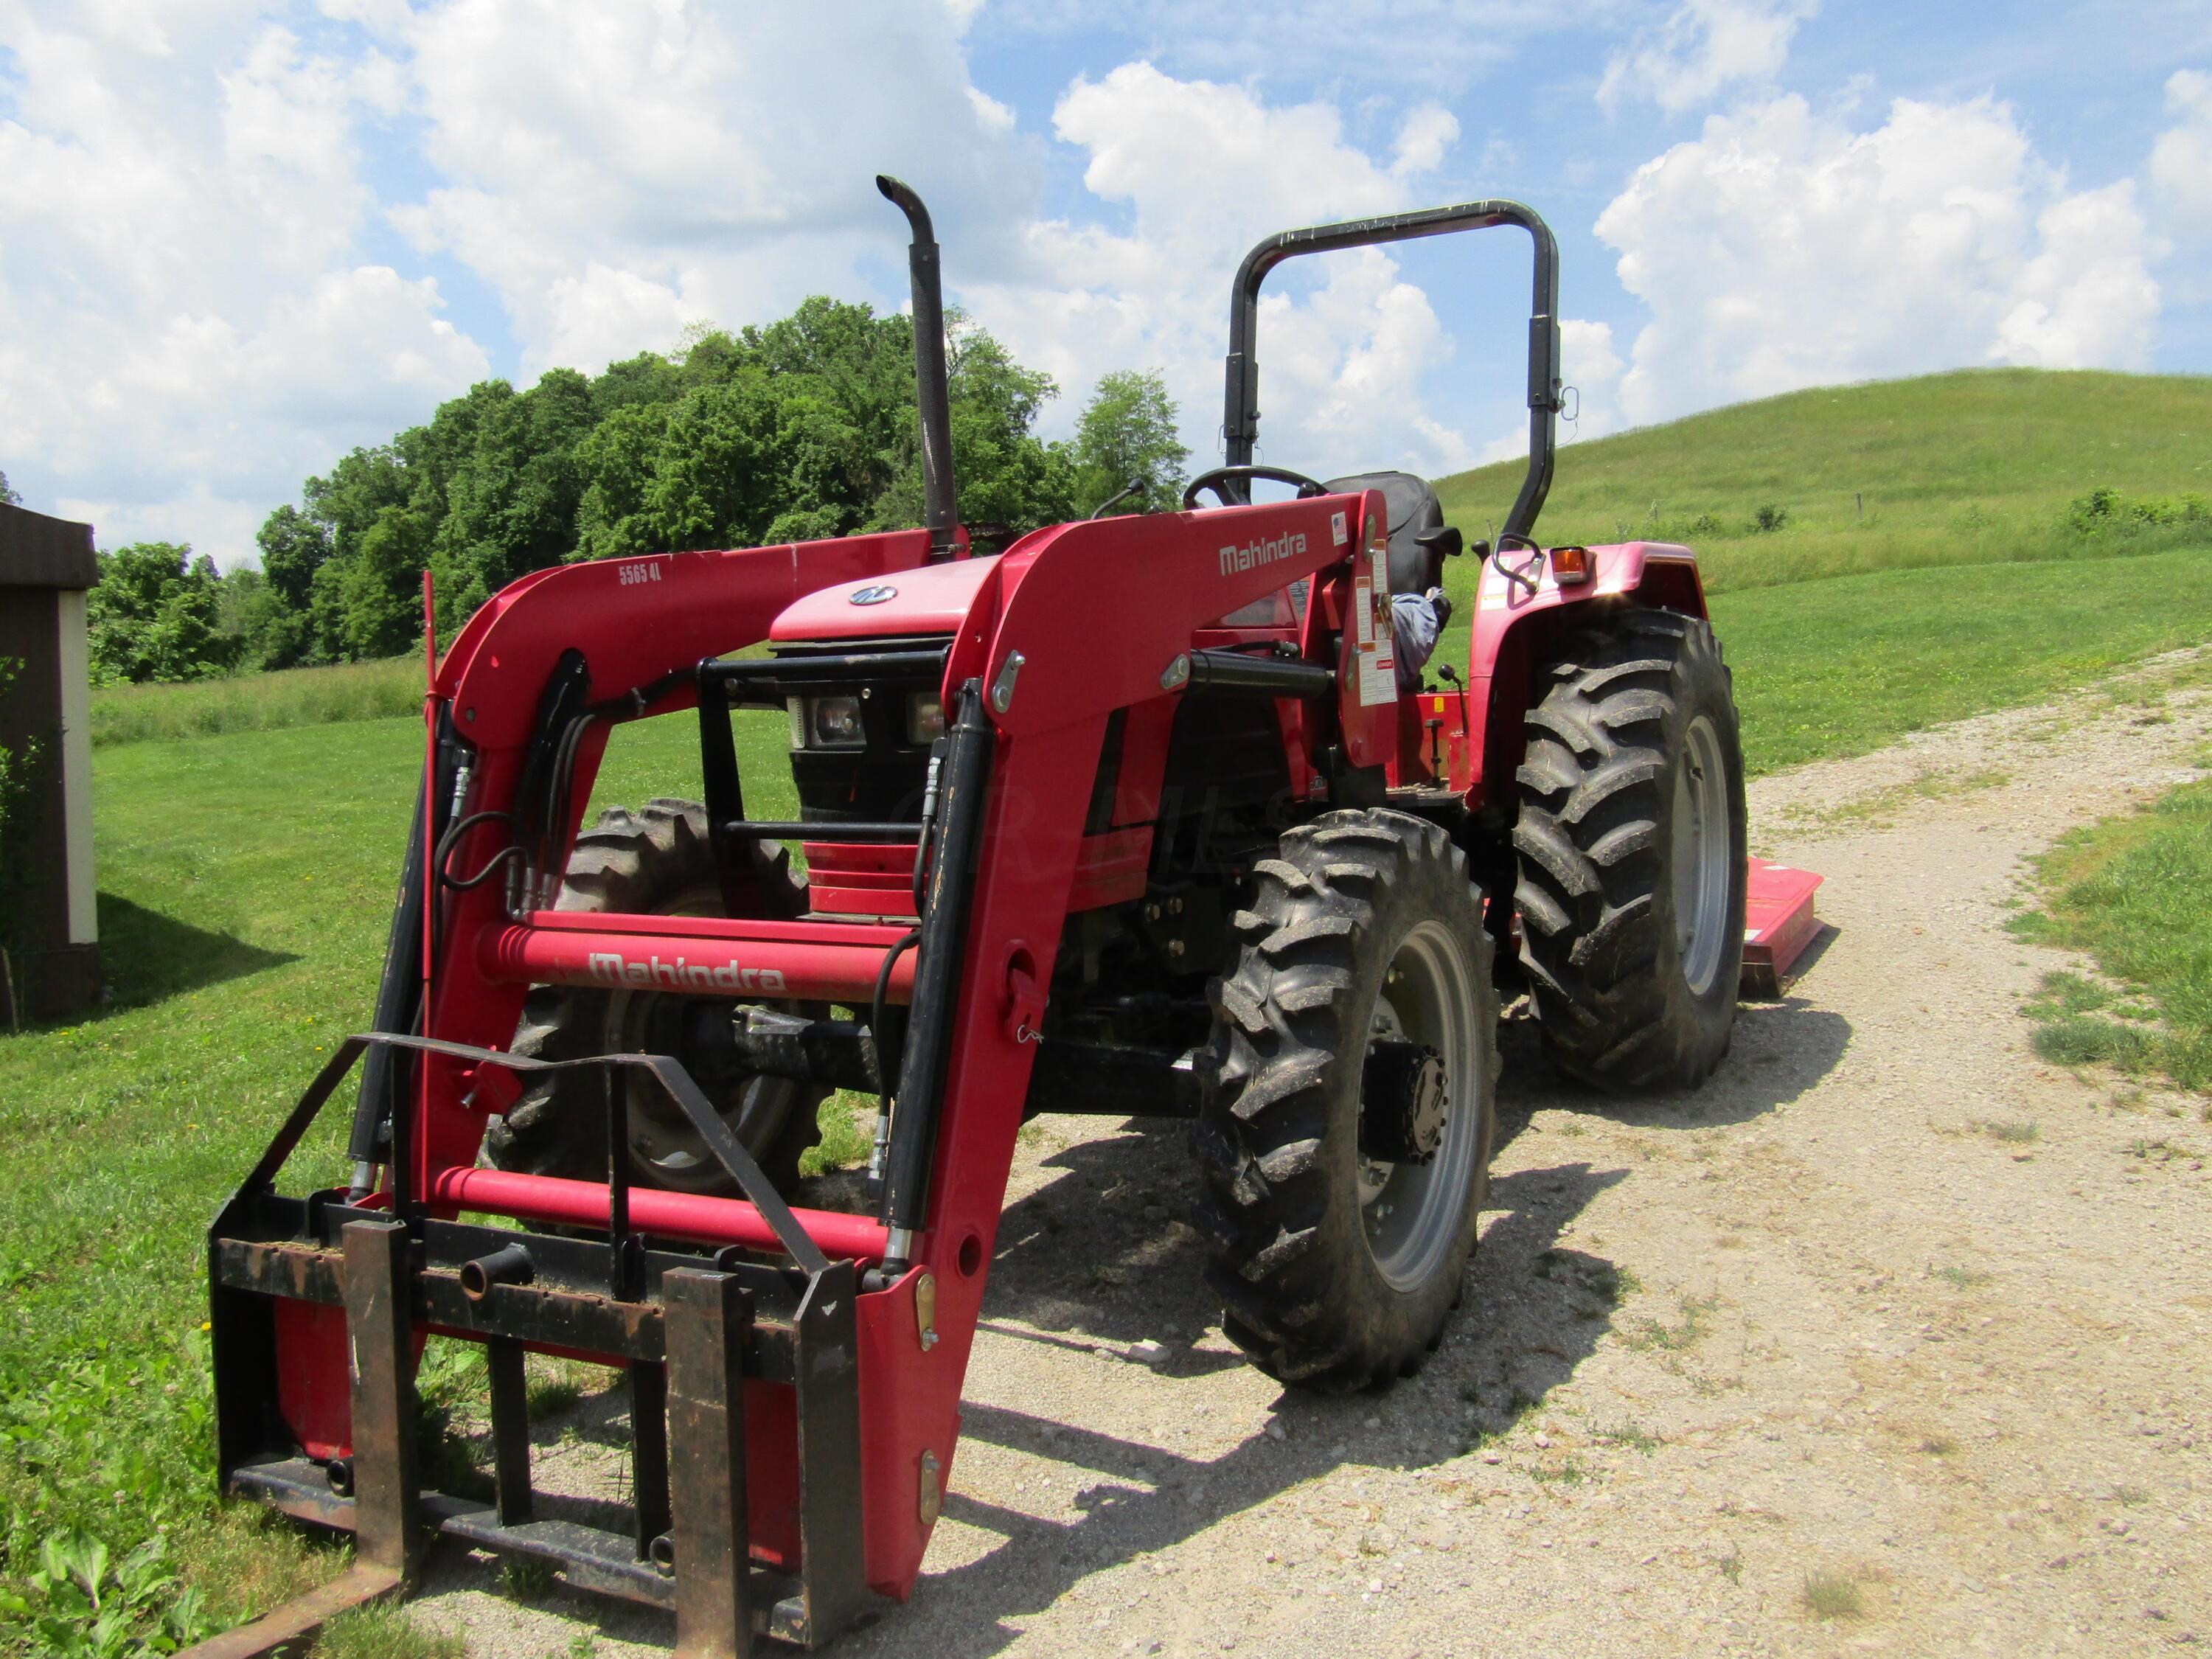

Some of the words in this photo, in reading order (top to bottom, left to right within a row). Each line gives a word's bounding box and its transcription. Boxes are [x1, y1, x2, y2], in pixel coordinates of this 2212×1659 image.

[1220, 532, 1307, 576] Mahindra
[619, 564, 647, 585] 5565
[589, 952, 787, 991] Mahindra
